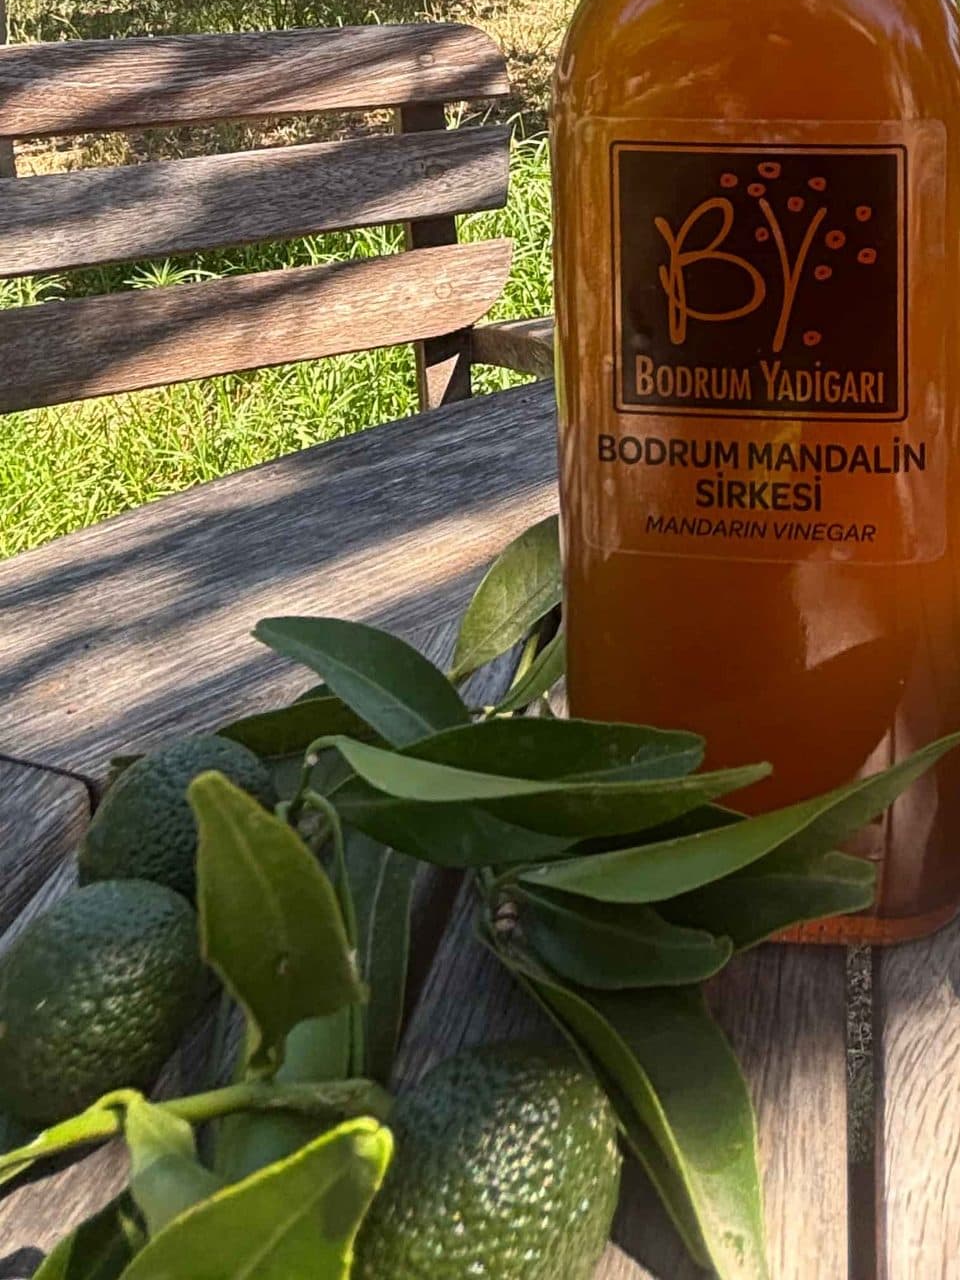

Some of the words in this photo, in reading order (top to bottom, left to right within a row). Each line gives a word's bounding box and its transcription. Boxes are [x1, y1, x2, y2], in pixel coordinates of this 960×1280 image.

[634, 354, 752, 402] BODRUM
[598, 434, 740, 470] BODRUM
[748, 436, 927, 474] MANDALİN
[695, 471, 823, 512] SİRKESİ
[645, 515, 767, 540] MANDARIN
[773, 522, 877, 543] VINEGAR
